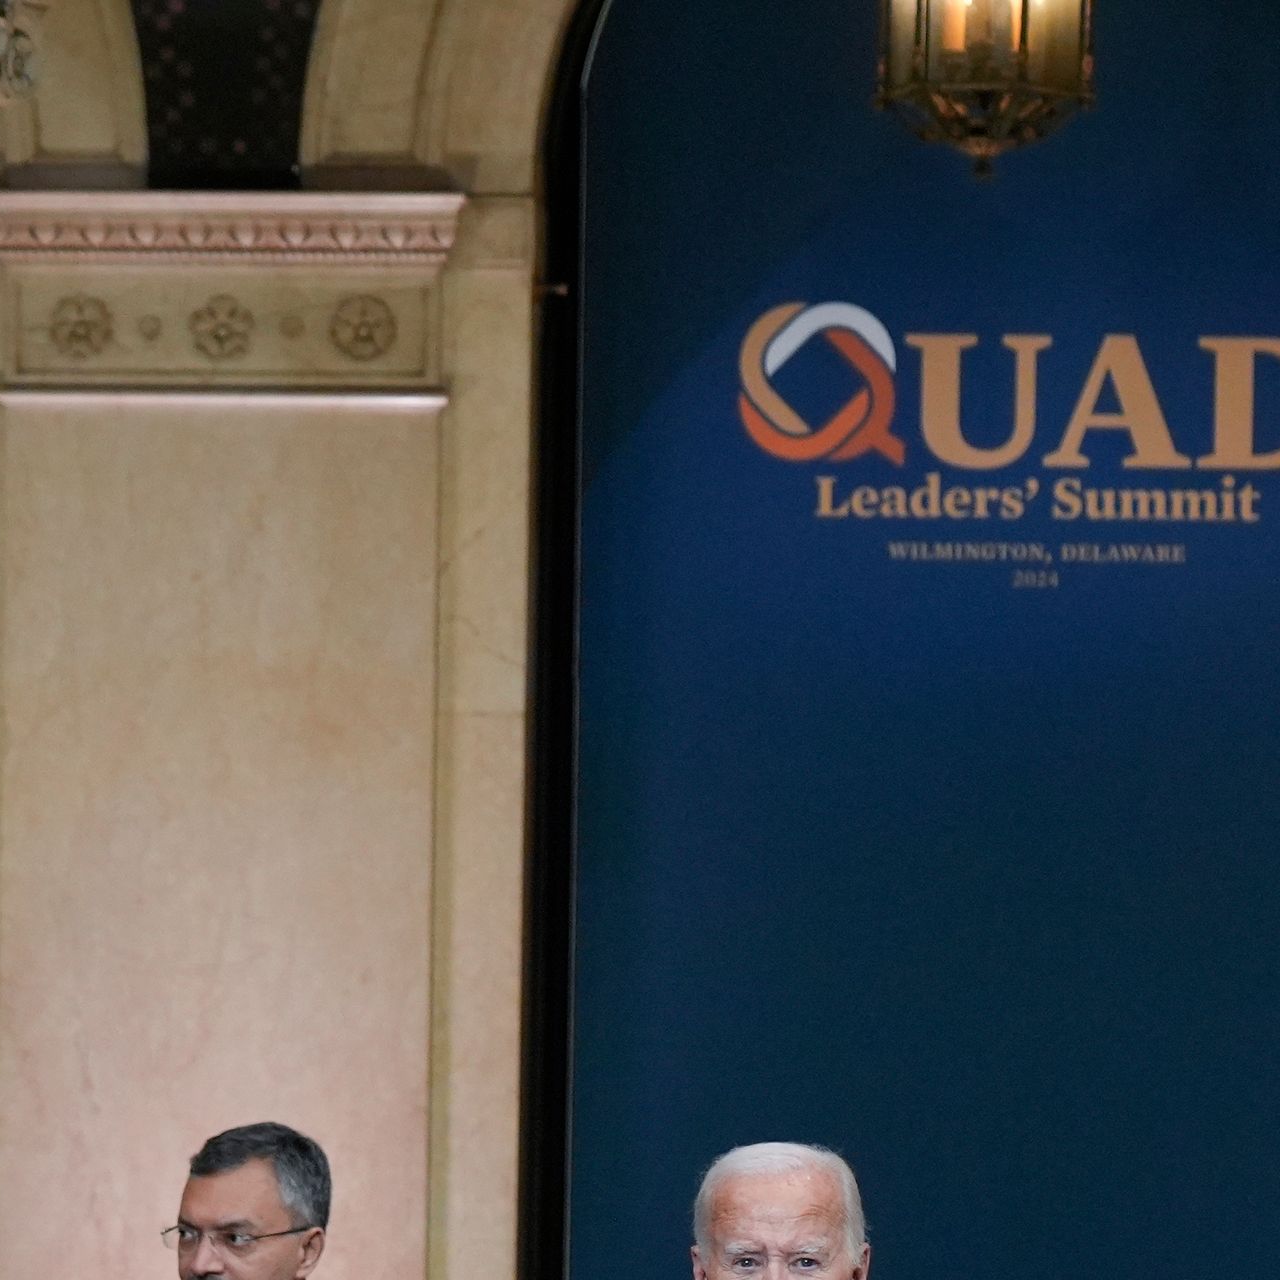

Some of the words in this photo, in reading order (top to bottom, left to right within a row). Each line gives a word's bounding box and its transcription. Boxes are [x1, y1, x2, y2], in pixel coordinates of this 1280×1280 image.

[814, 471, 1039, 521] Leaders’
[1051, 475, 1261, 523] Summit
[888, 541, 1053, 564] WILMINGTON,
[1061, 543, 1186, 563] DELAWARE
[1013, 570, 1059, 588] 2024
